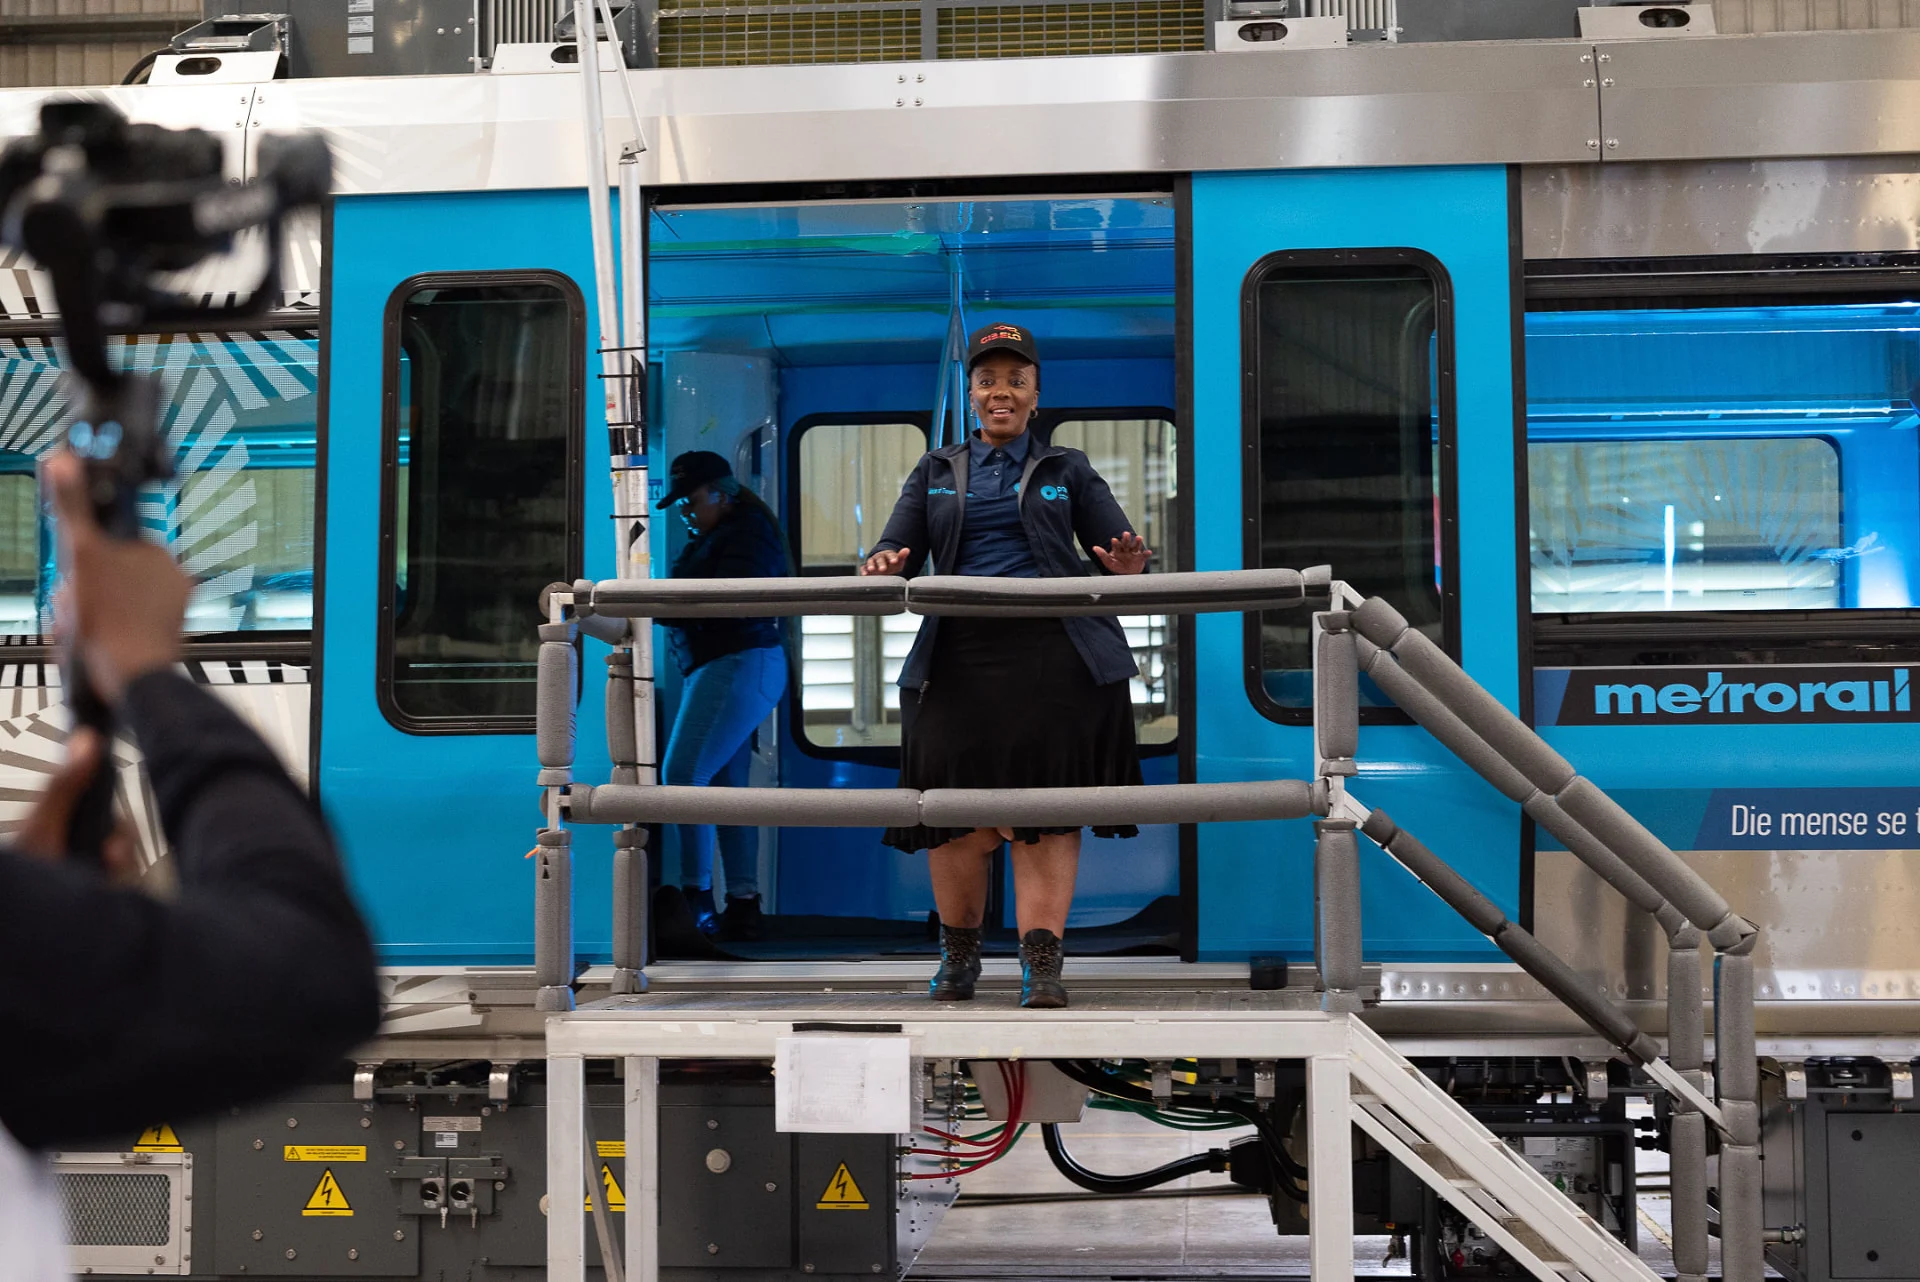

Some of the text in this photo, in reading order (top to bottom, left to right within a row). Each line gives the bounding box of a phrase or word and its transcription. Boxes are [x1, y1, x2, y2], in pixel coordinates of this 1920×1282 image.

[1595, 668, 1911, 714] metrorail
[1732, 805, 1772, 836] Die
[1781, 812, 1868, 836] mense
[1876, 812, 1907, 836] se
